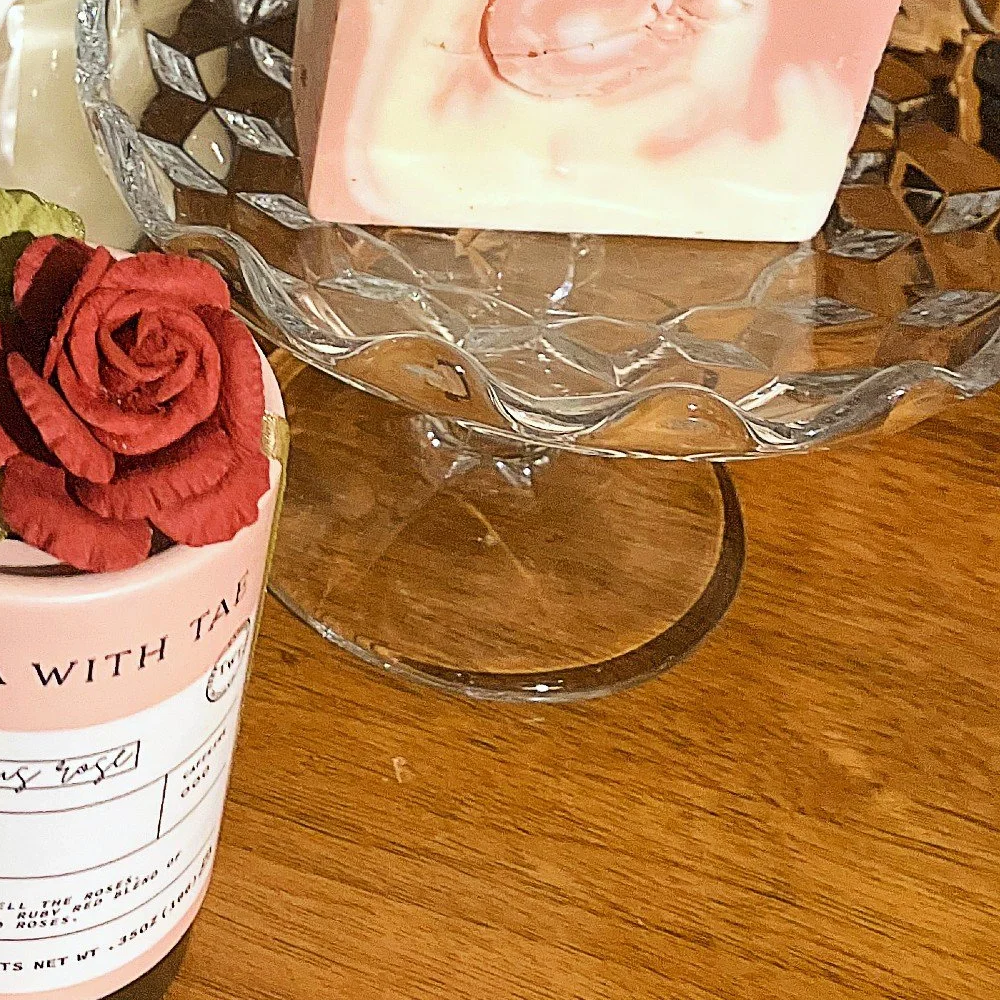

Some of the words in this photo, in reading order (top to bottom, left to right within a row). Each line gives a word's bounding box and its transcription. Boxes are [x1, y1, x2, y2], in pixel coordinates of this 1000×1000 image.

[32, 634, 169, 687] WITH
[55, 749, 134, 785] rose
[17, 908, 61, 919] RUBY
[72, 898, 103, 913] RED
[113, 870, 158, 899] BLEND
[42, 896, 72, 909] THE
[33, 956, 69, 971] NET
[76, 947, 100, 962] WT
